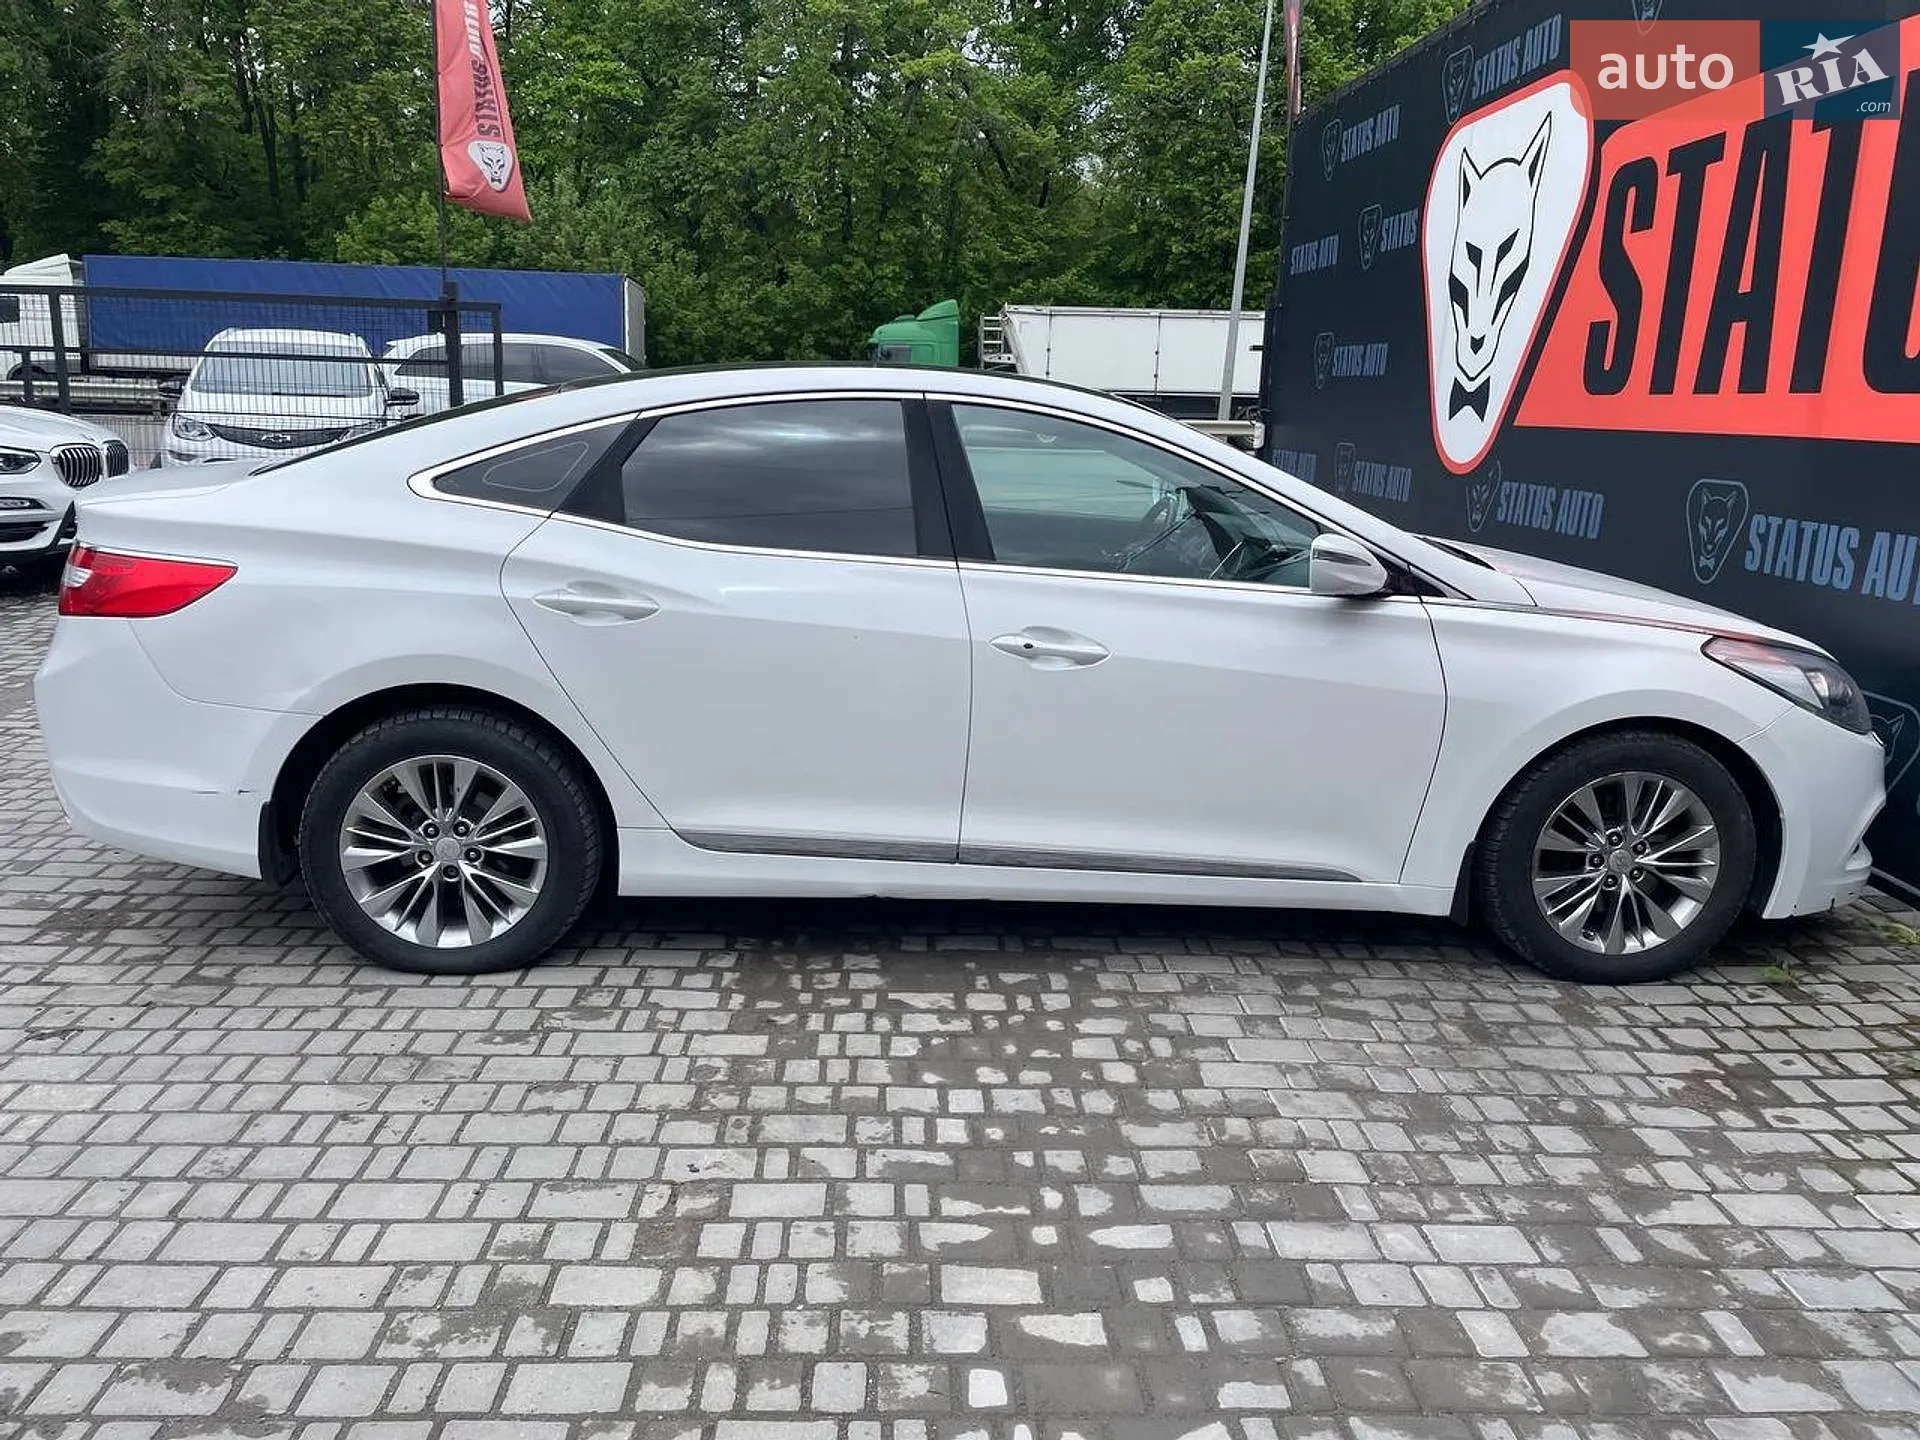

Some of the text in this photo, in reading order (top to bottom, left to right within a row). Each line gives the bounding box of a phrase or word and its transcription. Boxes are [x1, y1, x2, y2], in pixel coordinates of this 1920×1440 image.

[1472, 13, 1562, 99] STATUS AUTO
[1341, 104, 1400, 163] STATUS AUTO
[1290, 235, 1340, 276] STATUS AUTO
[1381, 208, 1419, 252] STATUS
[1331, 343, 1389, 377] STATUS AUTO
[1352, 461, 1412, 502] STATUS AUTO
[1497, 481, 1604, 539] STATUS AUTO
[1744, 513, 1920, 605] STATUS AU
